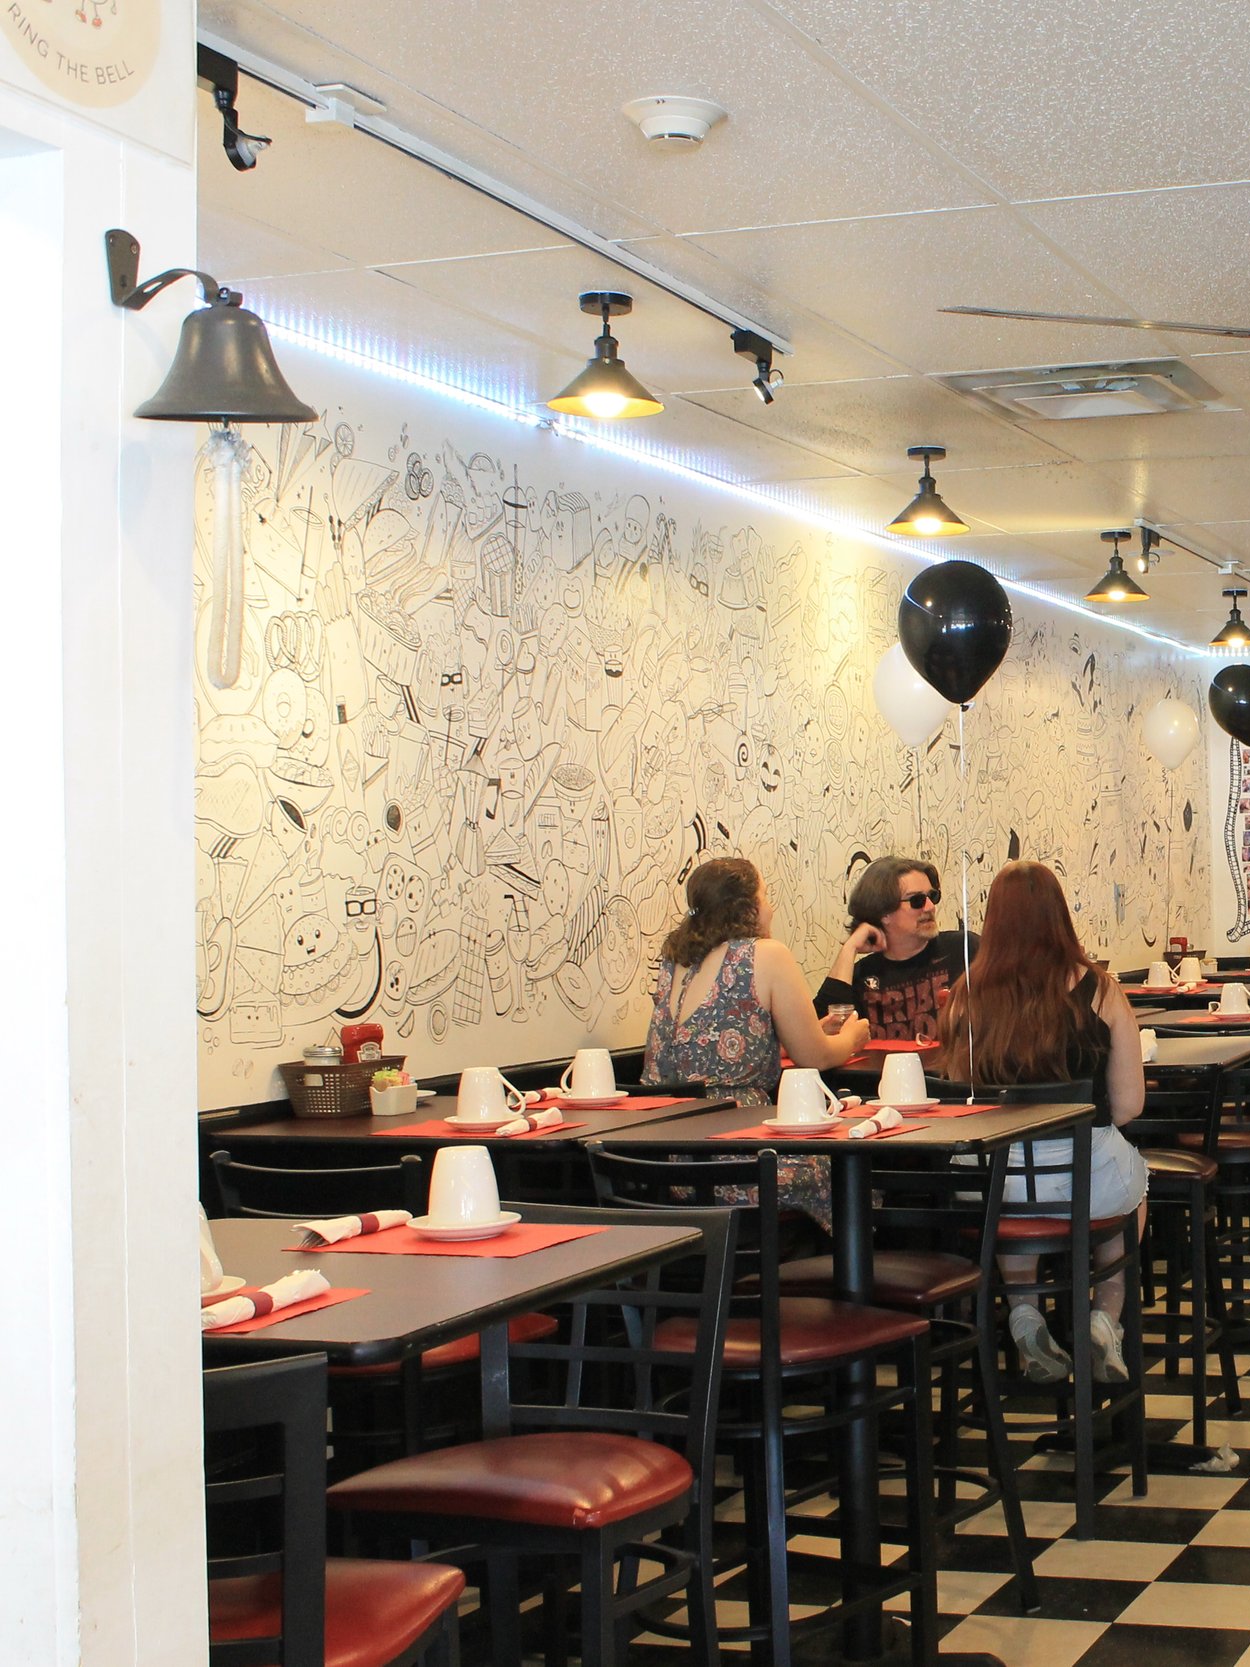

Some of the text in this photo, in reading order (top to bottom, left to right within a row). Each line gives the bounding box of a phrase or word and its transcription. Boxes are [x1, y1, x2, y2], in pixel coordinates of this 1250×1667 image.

[8, 3, 135, 85] RING THE BELL
